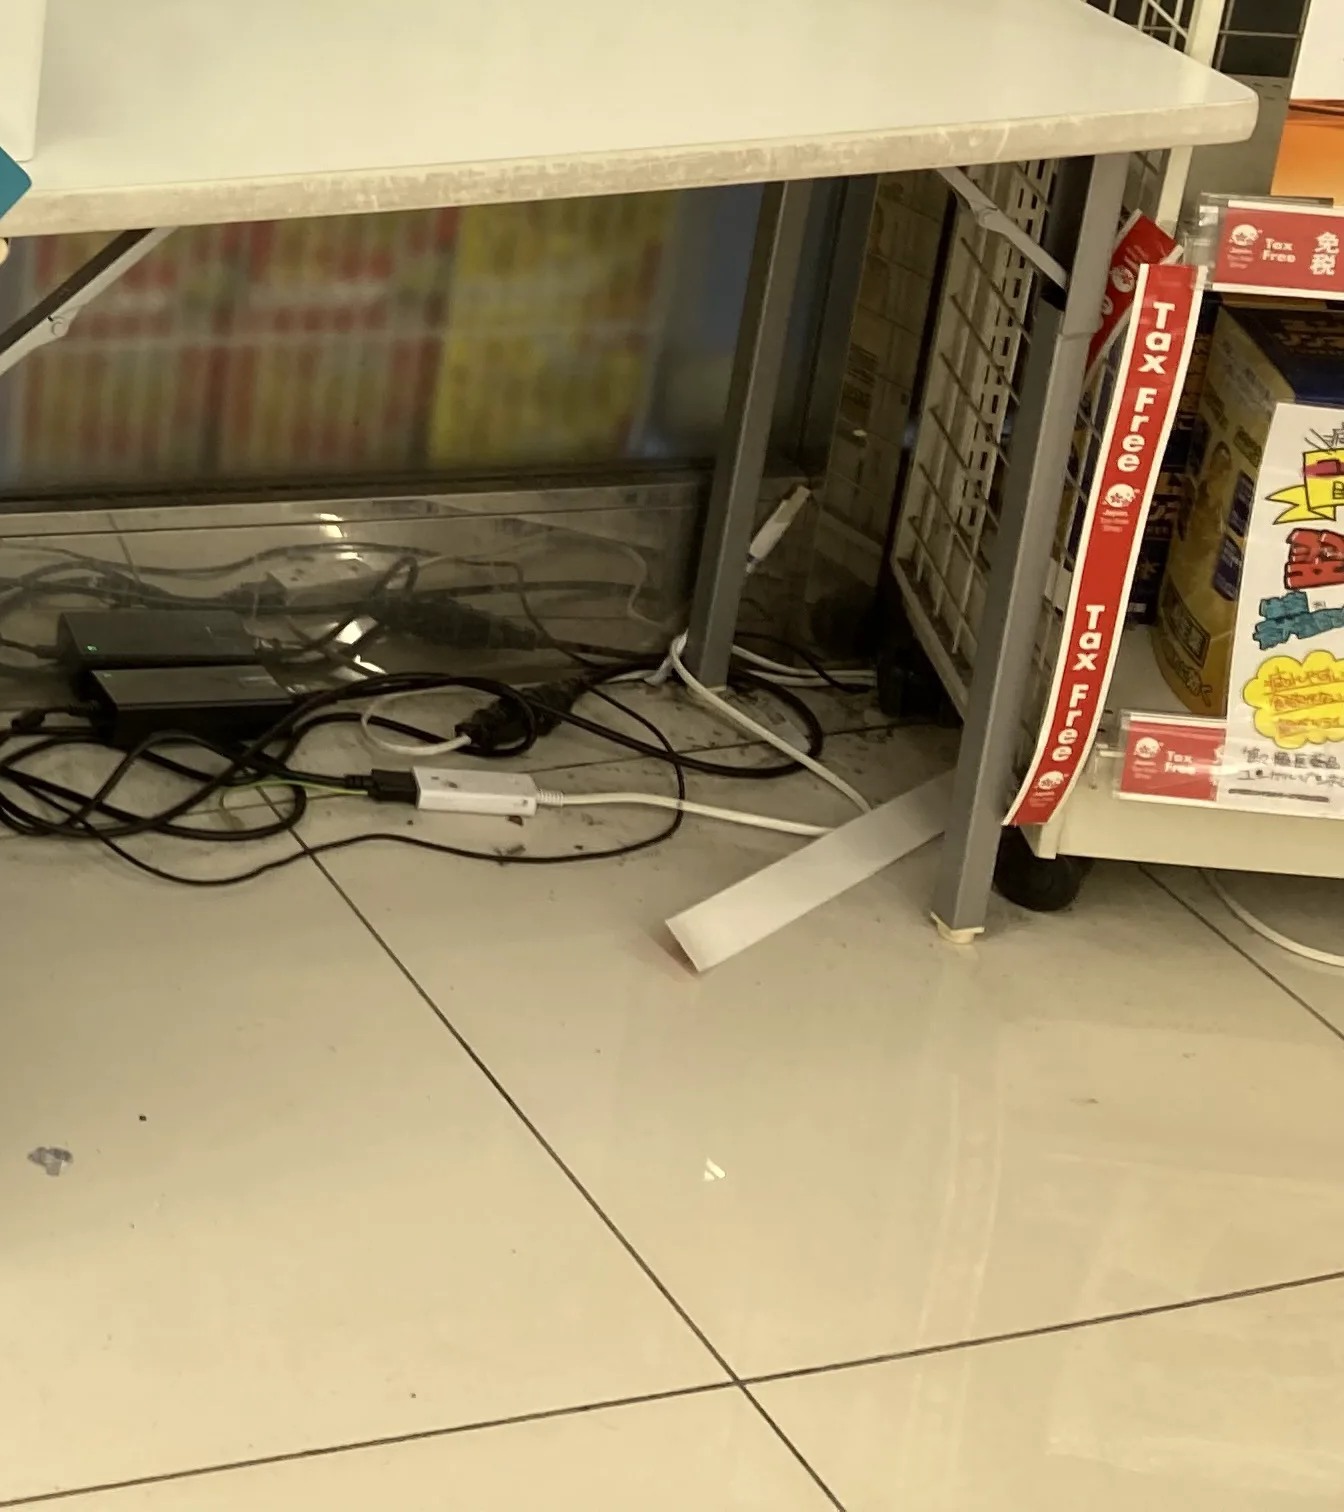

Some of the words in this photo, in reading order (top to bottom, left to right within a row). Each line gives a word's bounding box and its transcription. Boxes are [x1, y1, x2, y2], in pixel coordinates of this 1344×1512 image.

[1138, 302, 1175, 374] Tax
[1117, 388, 1157, 472] Free
[1072, 605, 1105, 671] Tax
[1052, 685, 1089, 761] Free
